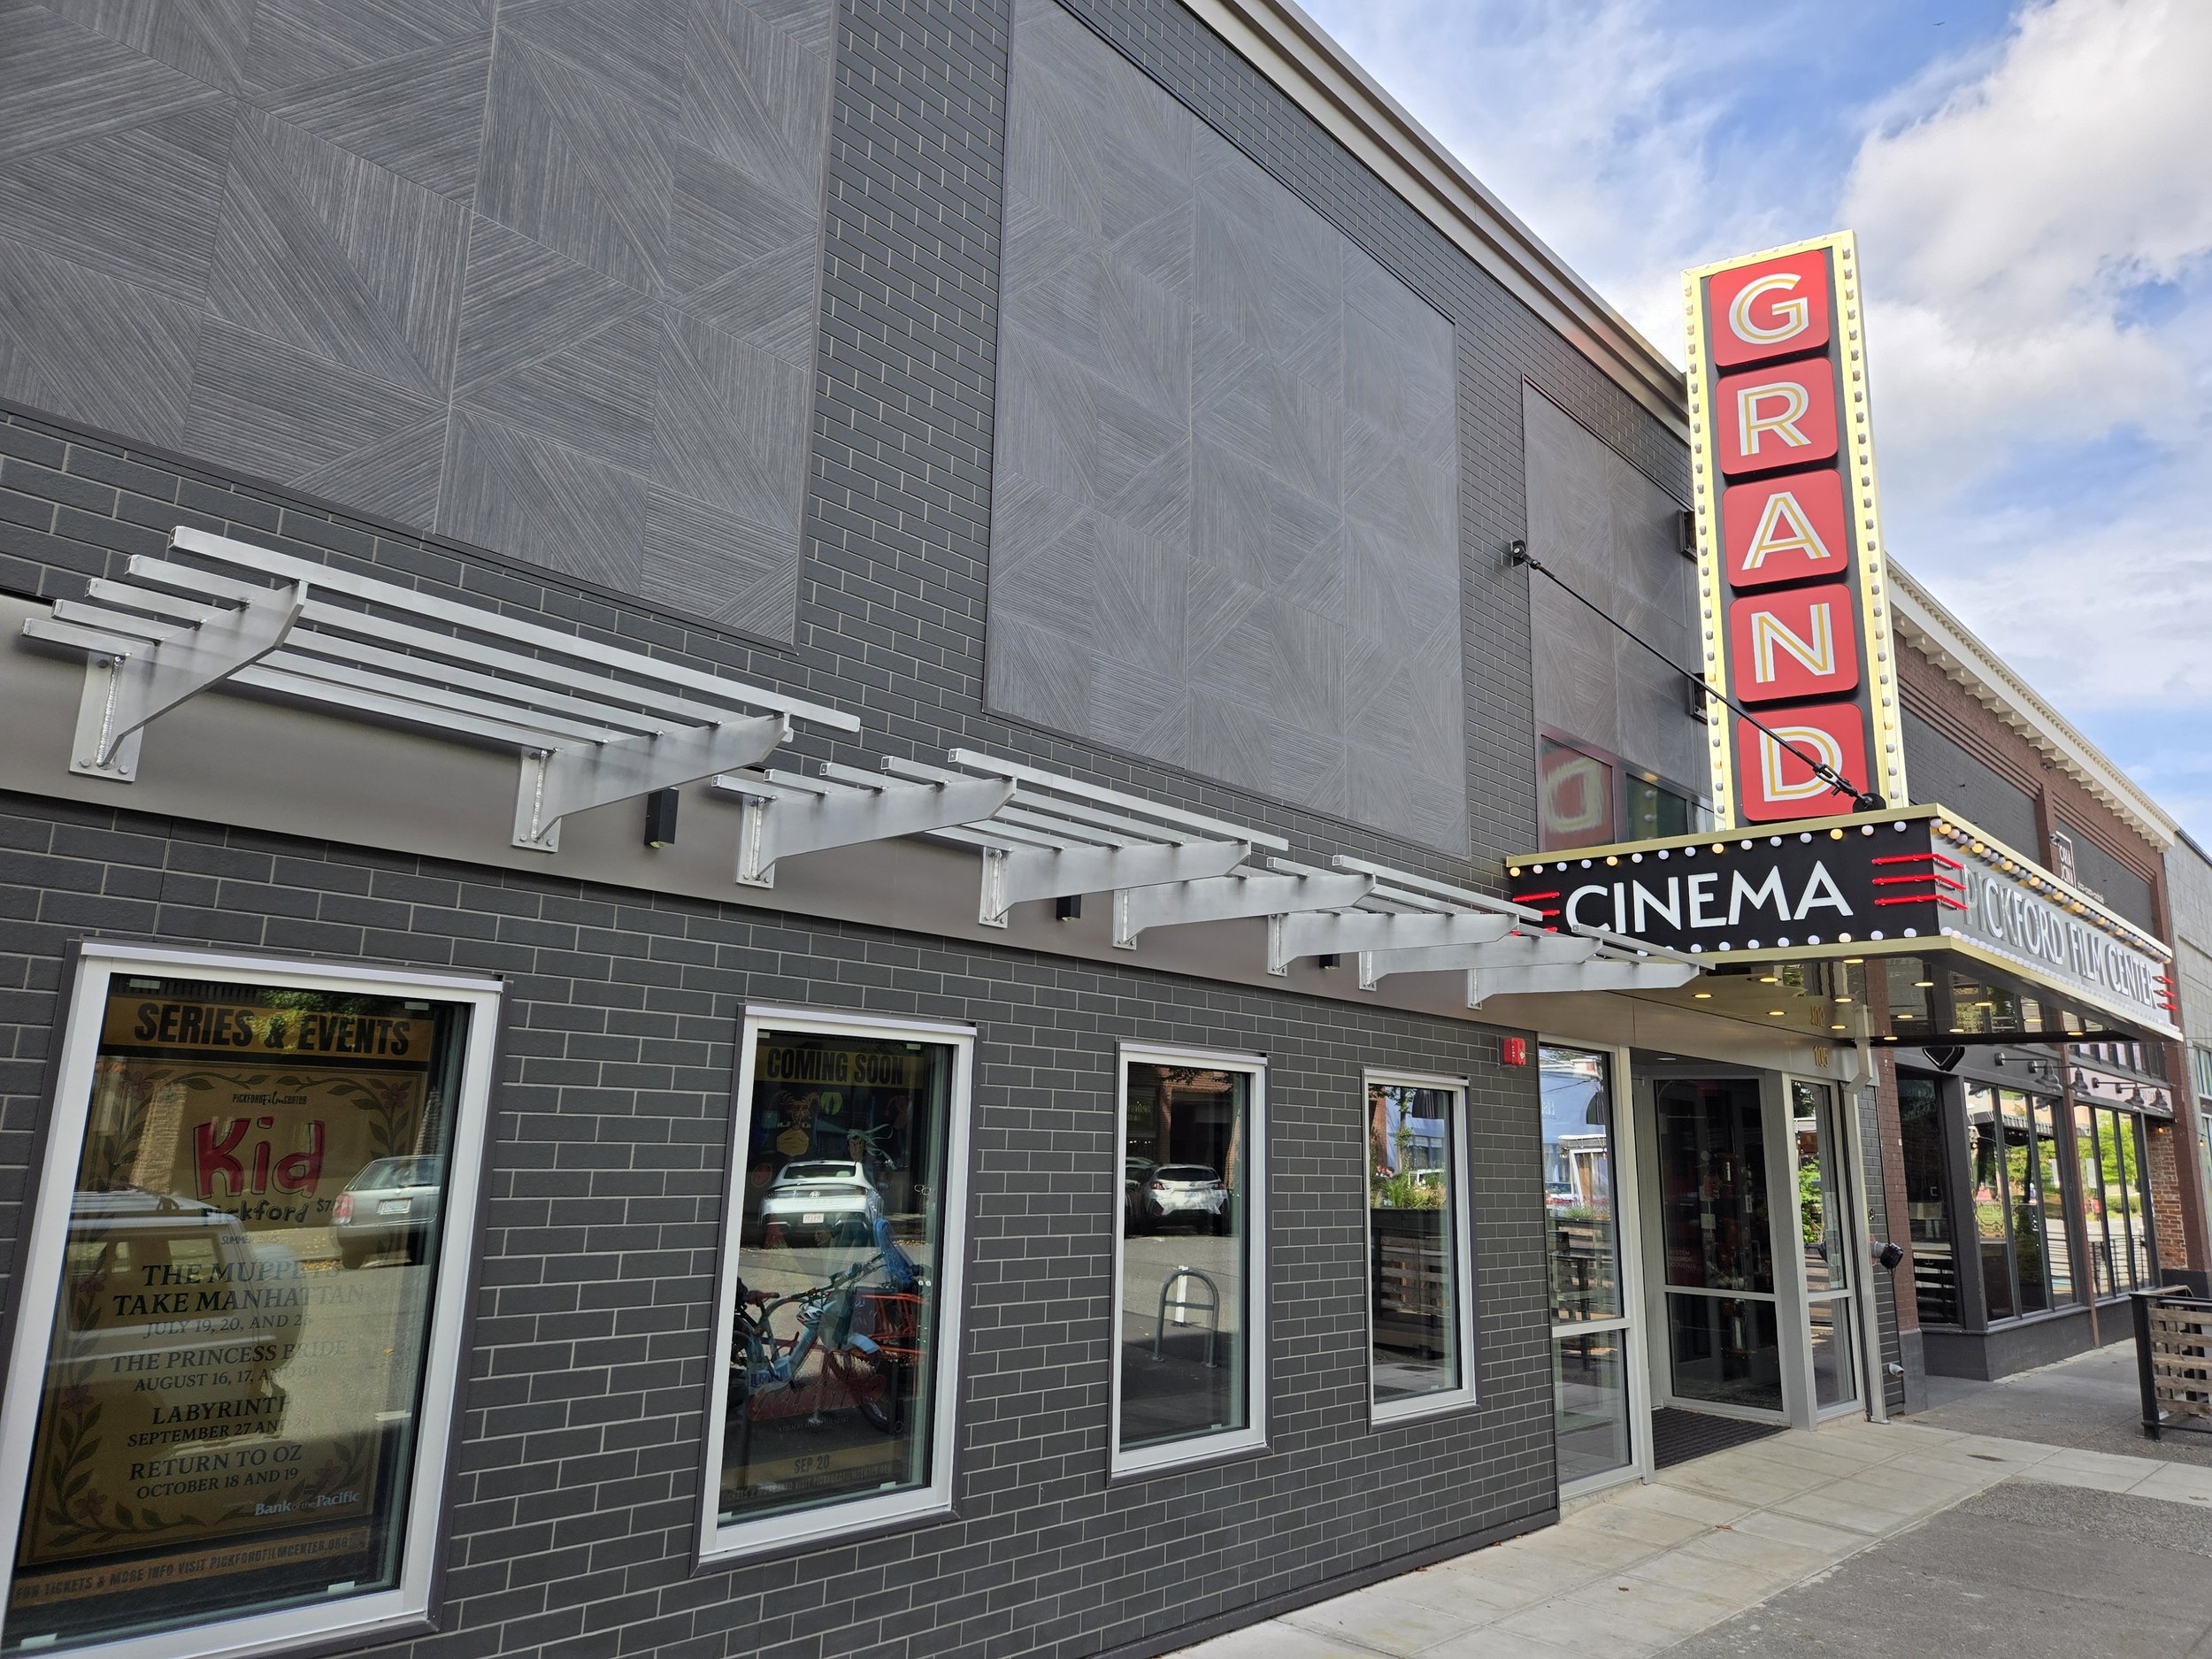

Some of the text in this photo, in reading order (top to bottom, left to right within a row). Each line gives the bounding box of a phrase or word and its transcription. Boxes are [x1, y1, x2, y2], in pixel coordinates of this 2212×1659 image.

[1728, 272, 1843, 803] GRAND
[1565, 859, 1855, 934] CINEMA
[1961, 864, 2157, 1010] PICKFORD FILM CENTER
[134, 1002, 411, 1056] SERIES & EVENTS
[766, 1047, 904, 1085] COMING SOON
[1812, 1045, 1830, 1068] 105
[193, 1116, 326, 1201] Kid
[142, 1263, 202, 1286] THE
[113, 1284, 366, 1316] TAKE MANHATTAN
[142, 1319, 192, 1339] JULY
[194, 1317, 215, 1335] 19,
[220, 1317, 244, 1333] 20,
[249, 1314, 289, 1330] AND
[111, 1340, 349, 1372] THE PRINCESS BRIDE
[134, 1372, 209, 1392] AUGUST
[212, 1371, 232, 1386] 16,
[237, 1369, 254, 1385] 17,
[127, 1425, 229, 1448] SEPTEMBER
[234, 1422, 251, 1435] 27
[128, 1444, 303, 1481] RETURN TO OZ
[794, 1454, 831, 1475] SEP 20
[136, 1467, 299, 1500] OCTOBER 18 AND 19
[255, 1500, 292, 1517] Bank
[315, 1490, 361, 1508] Pacific
[45, 1578, 94, 1594] TICKETS
[109, 1570, 144, 1586] MORE
[148, 1564, 174, 1579] INFO
[178, 1559, 207, 1574] VISIT
